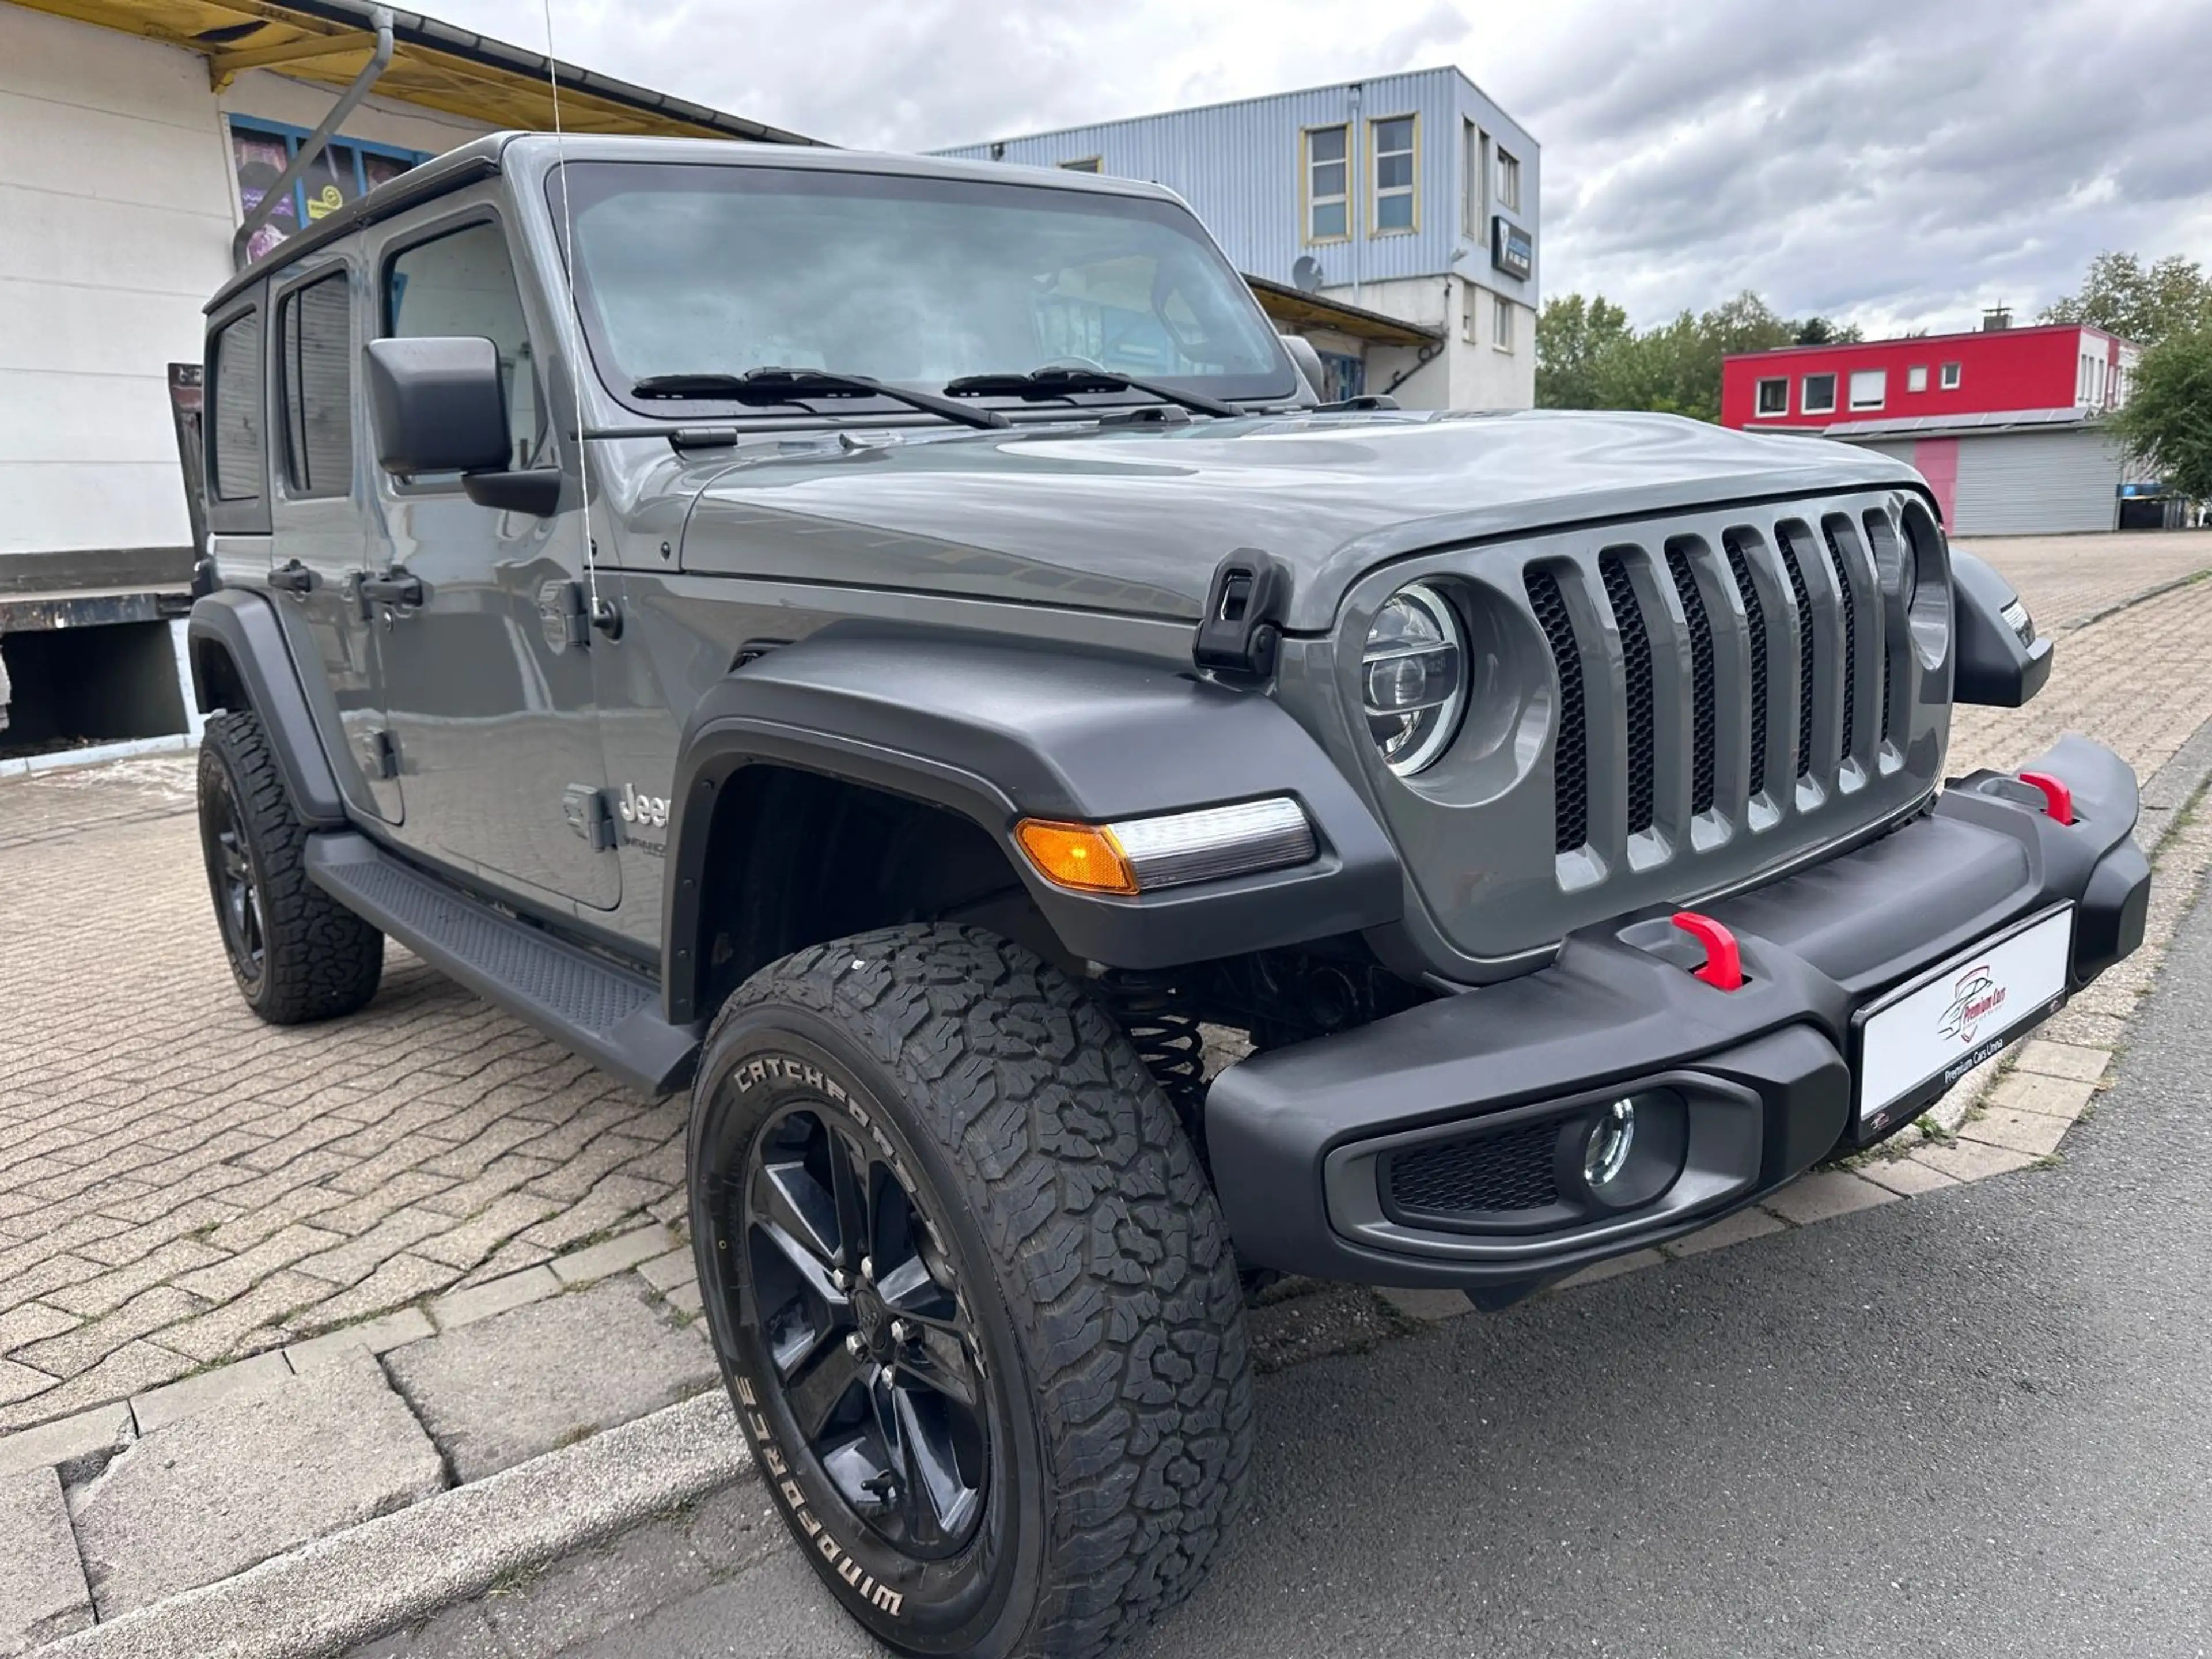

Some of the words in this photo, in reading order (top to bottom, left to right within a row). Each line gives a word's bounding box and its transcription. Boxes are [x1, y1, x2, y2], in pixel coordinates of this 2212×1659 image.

[1963, 995, 1993, 1025] Premium
[1945, 1058, 1973, 1084] Premium
[1972, 1049, 1987, 1065] Cars
[1986, 1038, 2003, 1056] Unna
[733, 1374, 904, 1618] WINDFORCE
